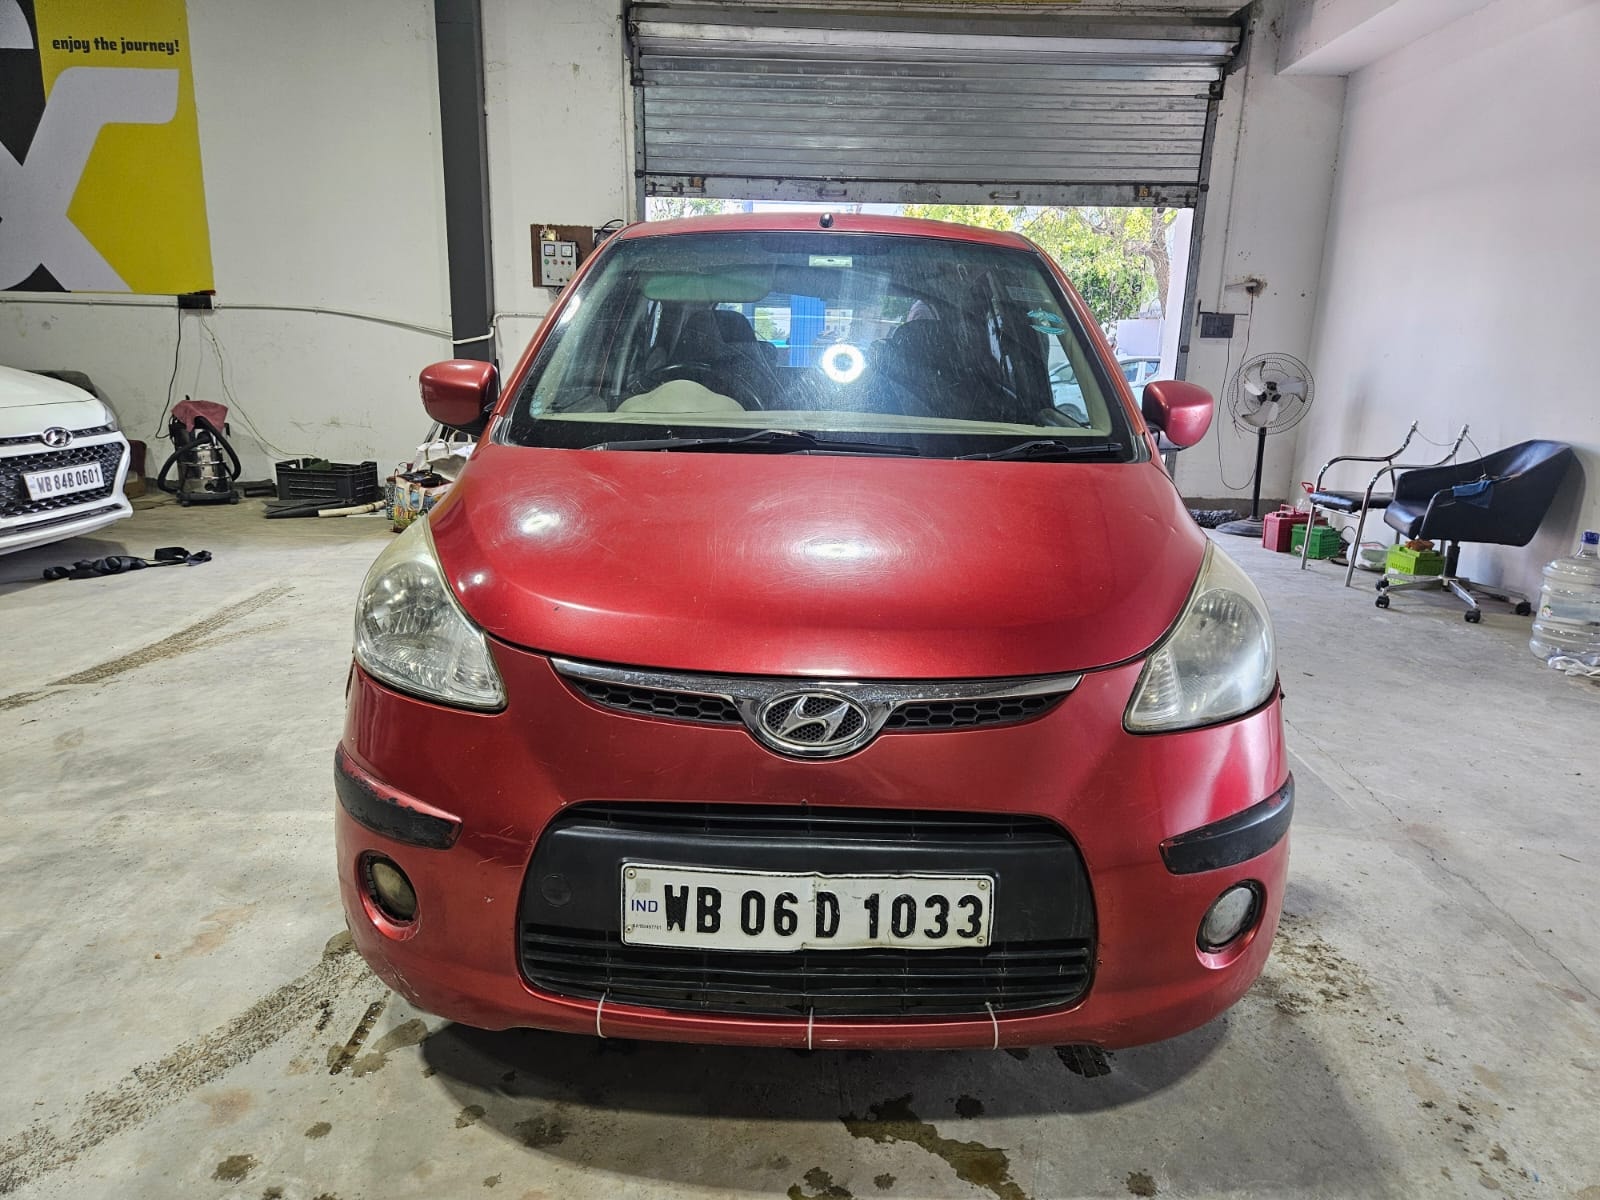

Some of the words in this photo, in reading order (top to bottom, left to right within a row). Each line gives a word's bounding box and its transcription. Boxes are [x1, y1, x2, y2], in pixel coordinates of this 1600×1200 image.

[53, 36, 91, 53] enjoy
[94, 37, 117, 51] the
[121, 37, 180, 56] journey!
[36, 476, 53, 494] WB
[54, 472, 75, 490] 84B
[76, 467, 101, 486] 0601
[631, 899, 658, 912] IND
[664, 884, 722, 934] WB
[741, 890, 799, 937] 06
[815, 891, 841, 938] D
[864, 893, 983, 939] 1033
